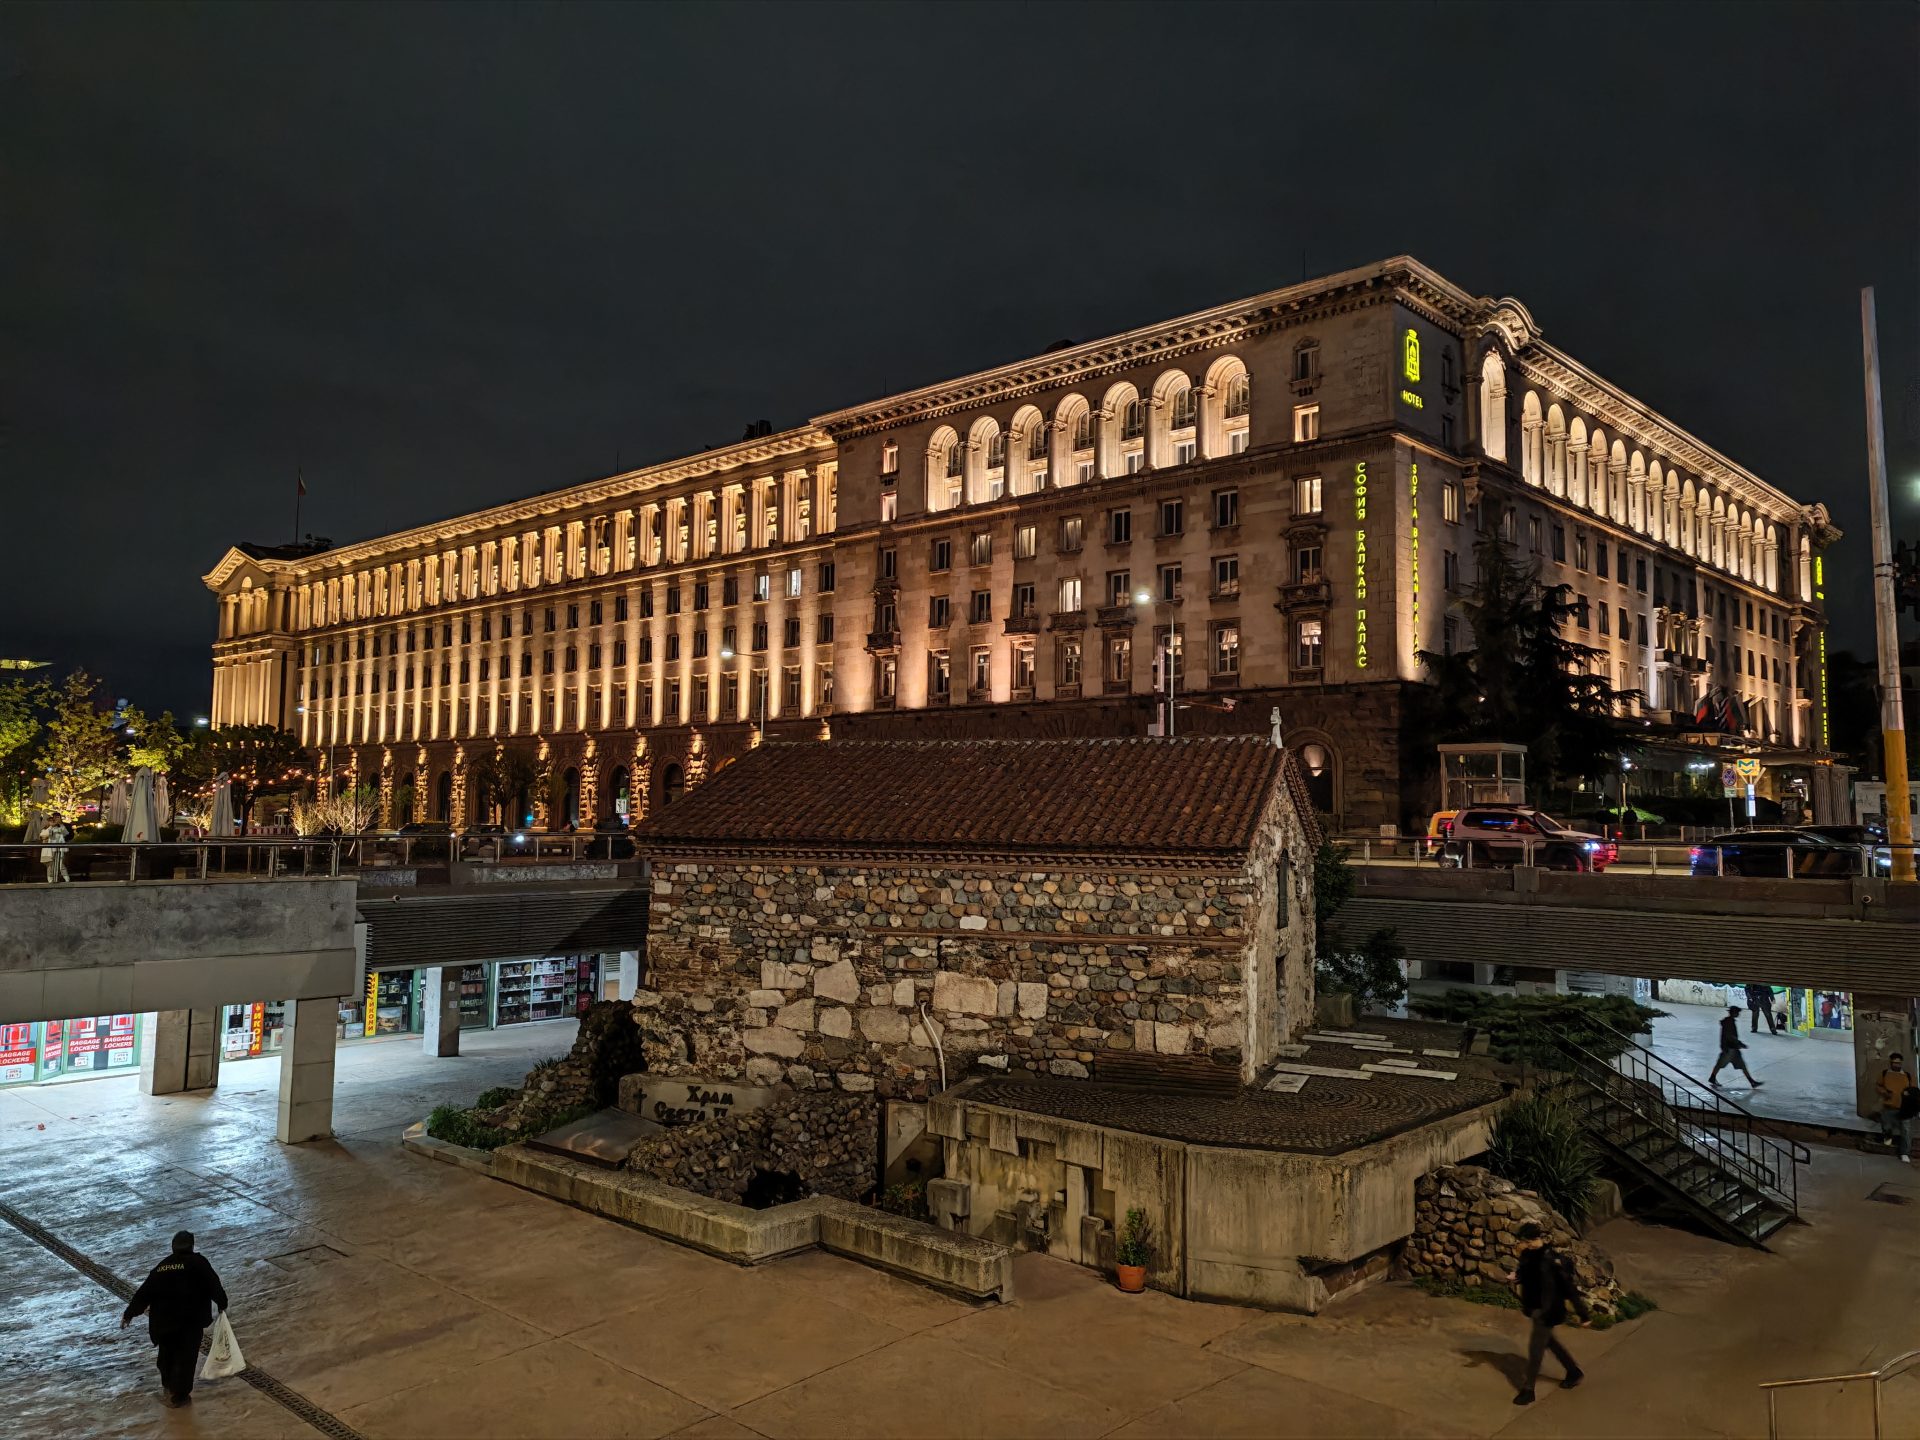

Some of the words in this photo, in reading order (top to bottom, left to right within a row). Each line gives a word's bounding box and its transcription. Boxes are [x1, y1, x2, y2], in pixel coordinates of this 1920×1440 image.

[1402, 390, 1424, 409] HOTEL
[1357, 462, 1367, 520] СОФИЯ
[1357, 530, 1367, 598] БАЛКАН
[1357, 609, 1367, 667] ПАЛАС
[70, 1038, 100, 1047] BAGGAGE
[103, 1035, 134, 1043] BAGGAGE
[104, 1041, 133, 1049] LOCKERS
[70, 1044, 100, 1052] LOCKERS
